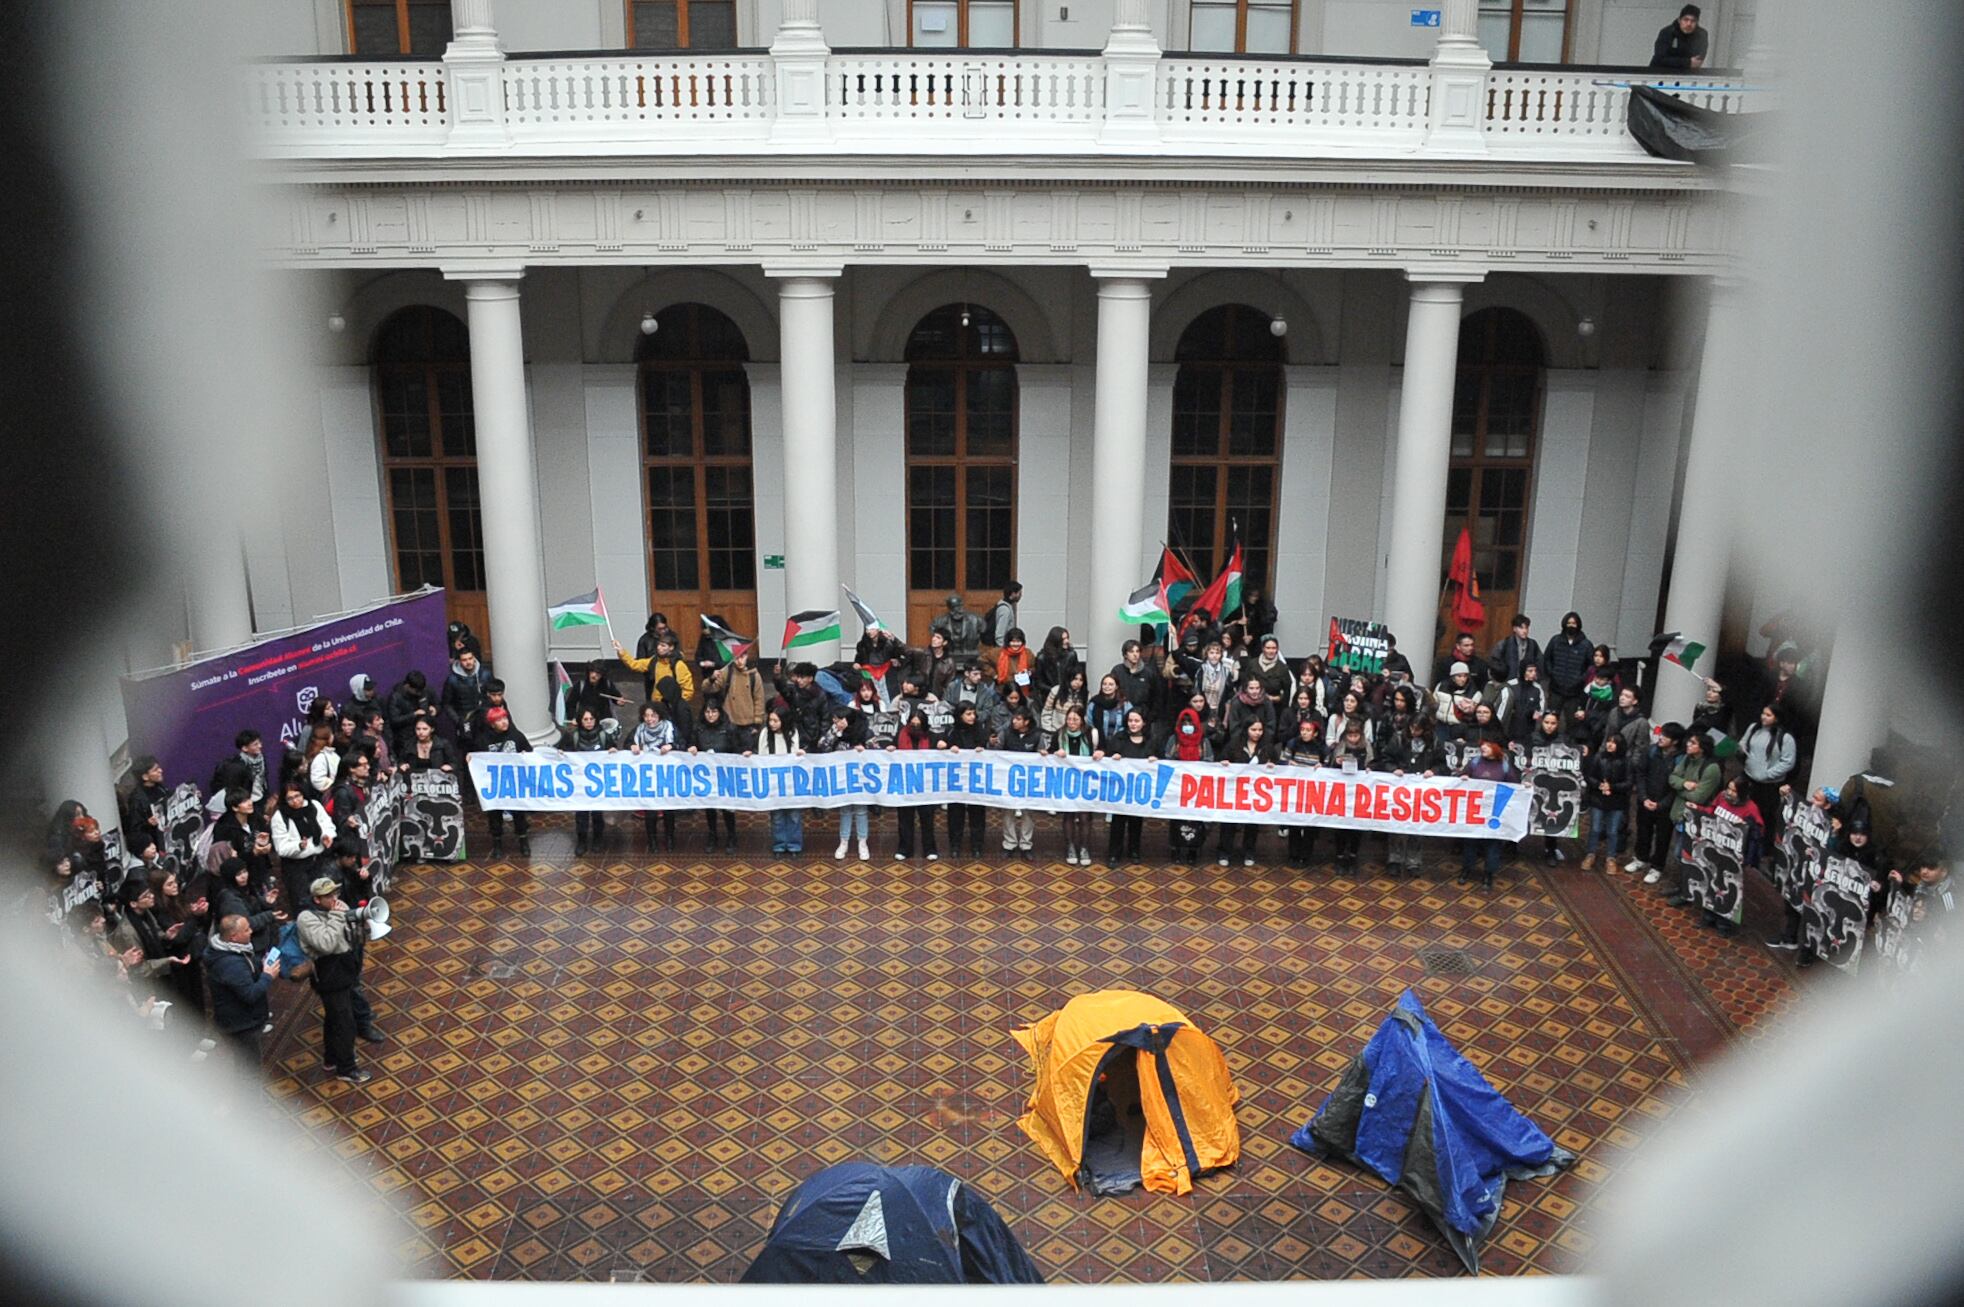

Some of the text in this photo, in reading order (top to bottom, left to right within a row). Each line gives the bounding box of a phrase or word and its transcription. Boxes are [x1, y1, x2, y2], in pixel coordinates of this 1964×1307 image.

[190, 674, 222, 691] Súmate
[229, 669, 238, 678] la
[311, 642, 322, 652] de
[322, 639, 331, 648] la
[331, 624, 374, 647] Universidad
[374, 623, 384, 632] de
[286, 663, 298, 673] en
[482, 761, 1516, 830] JAMAS SEREMOS NEUTRALES ANTE EL GENOCIDIO! PALESTINA RESISTE!
